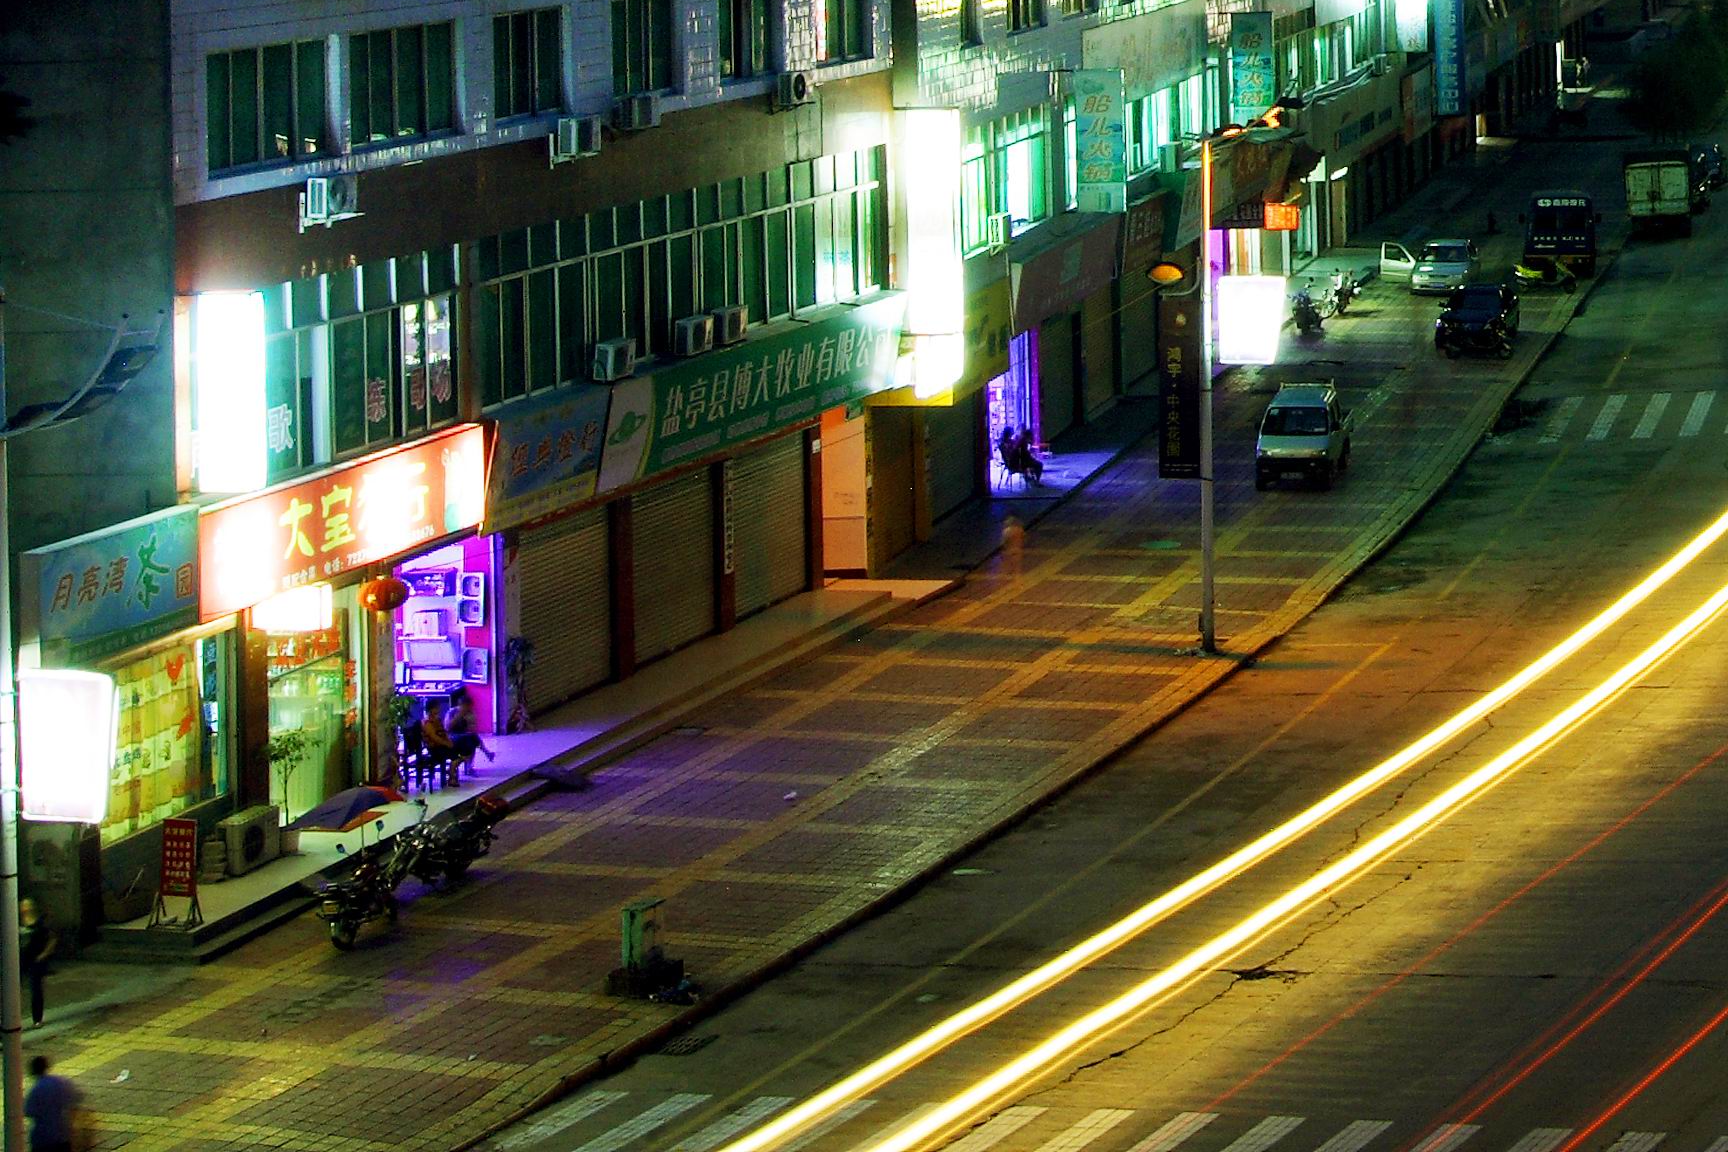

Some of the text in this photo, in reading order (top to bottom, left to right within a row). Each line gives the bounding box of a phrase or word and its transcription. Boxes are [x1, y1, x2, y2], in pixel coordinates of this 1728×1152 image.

[278, 461, 429, 560] 大宝行
[51, 533, 194, 613] 月亮湾茶园
